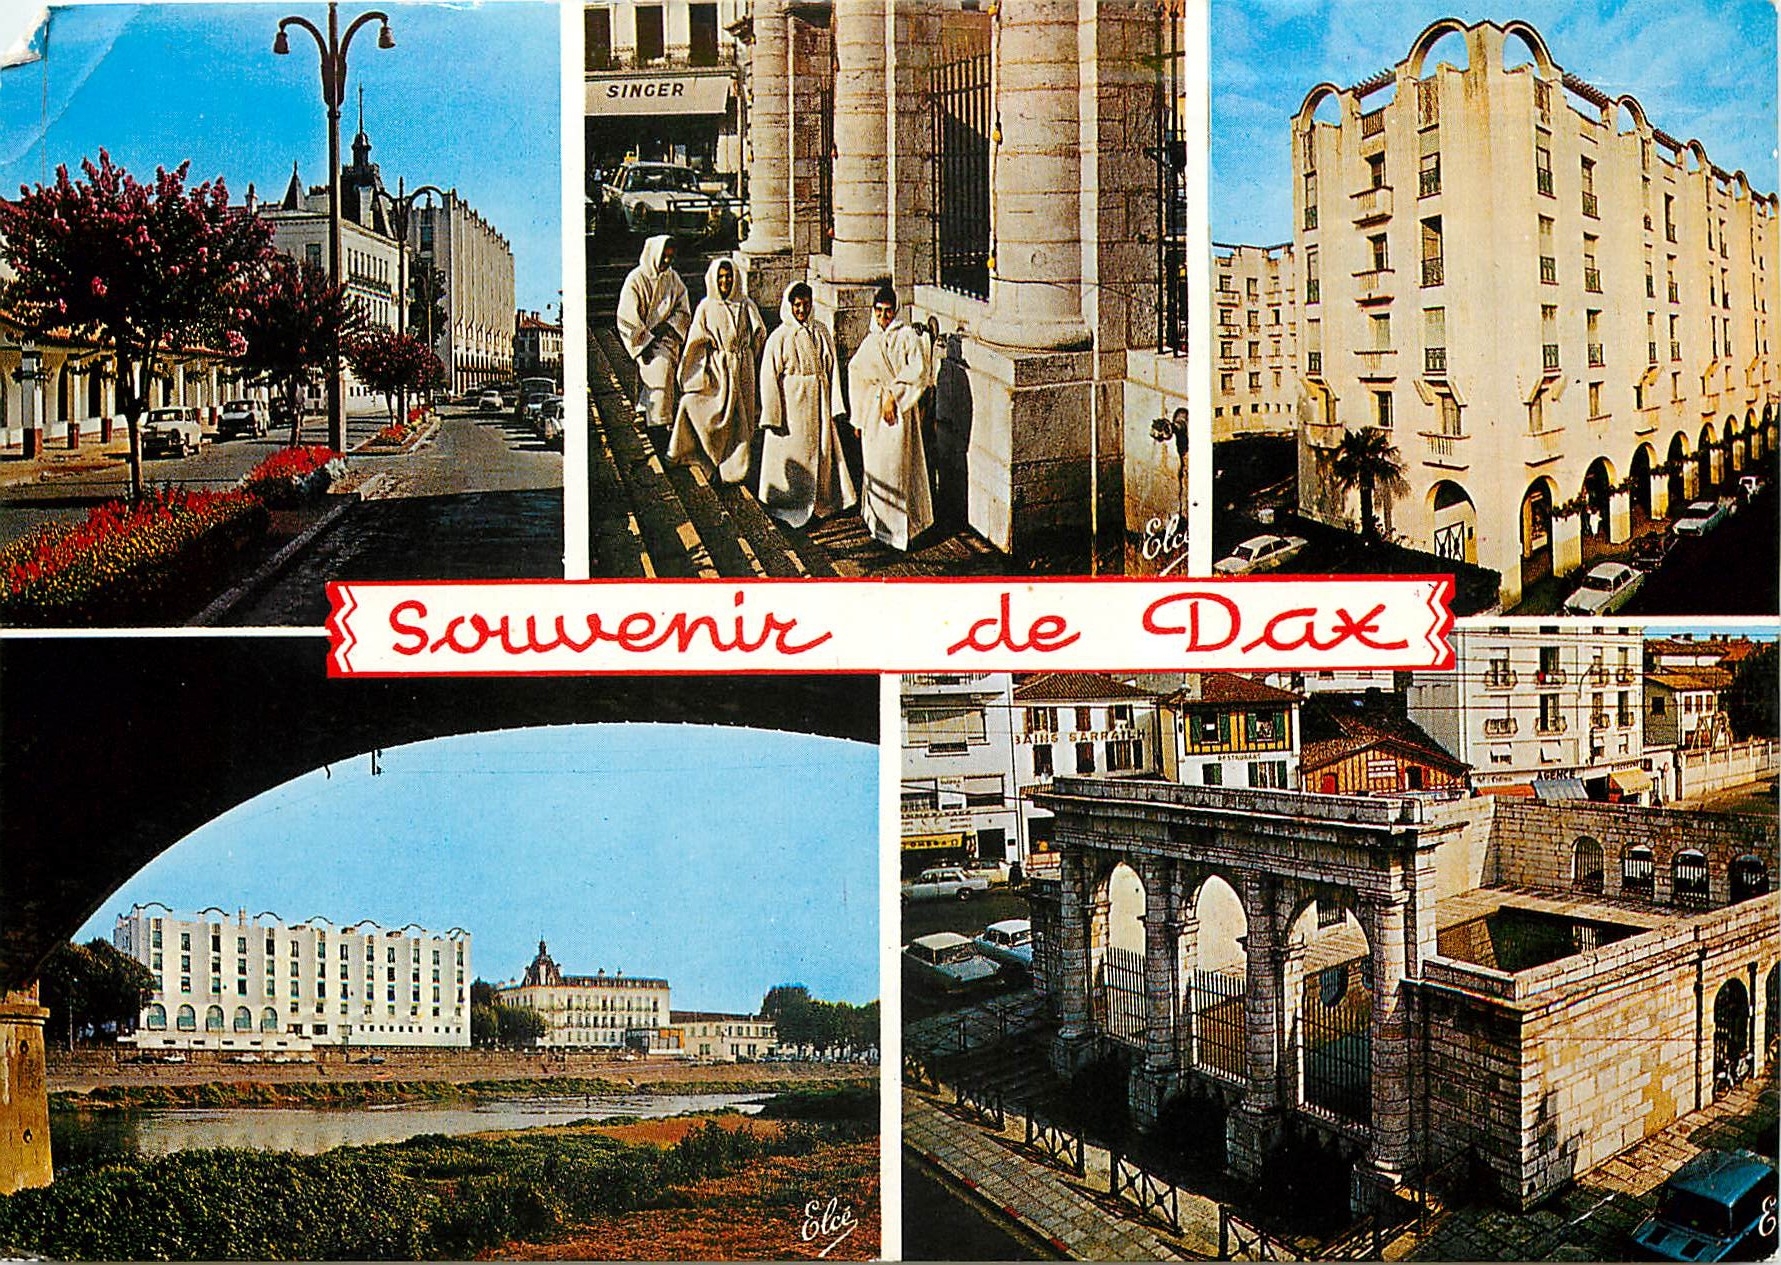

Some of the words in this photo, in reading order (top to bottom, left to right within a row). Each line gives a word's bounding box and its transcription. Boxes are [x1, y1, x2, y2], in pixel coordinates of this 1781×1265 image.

[606, 82, 684, 98] SINGER
[1069, 729, 1146, 742] SARRAILH
[1537, 769, 1575, 780] AGENCE
